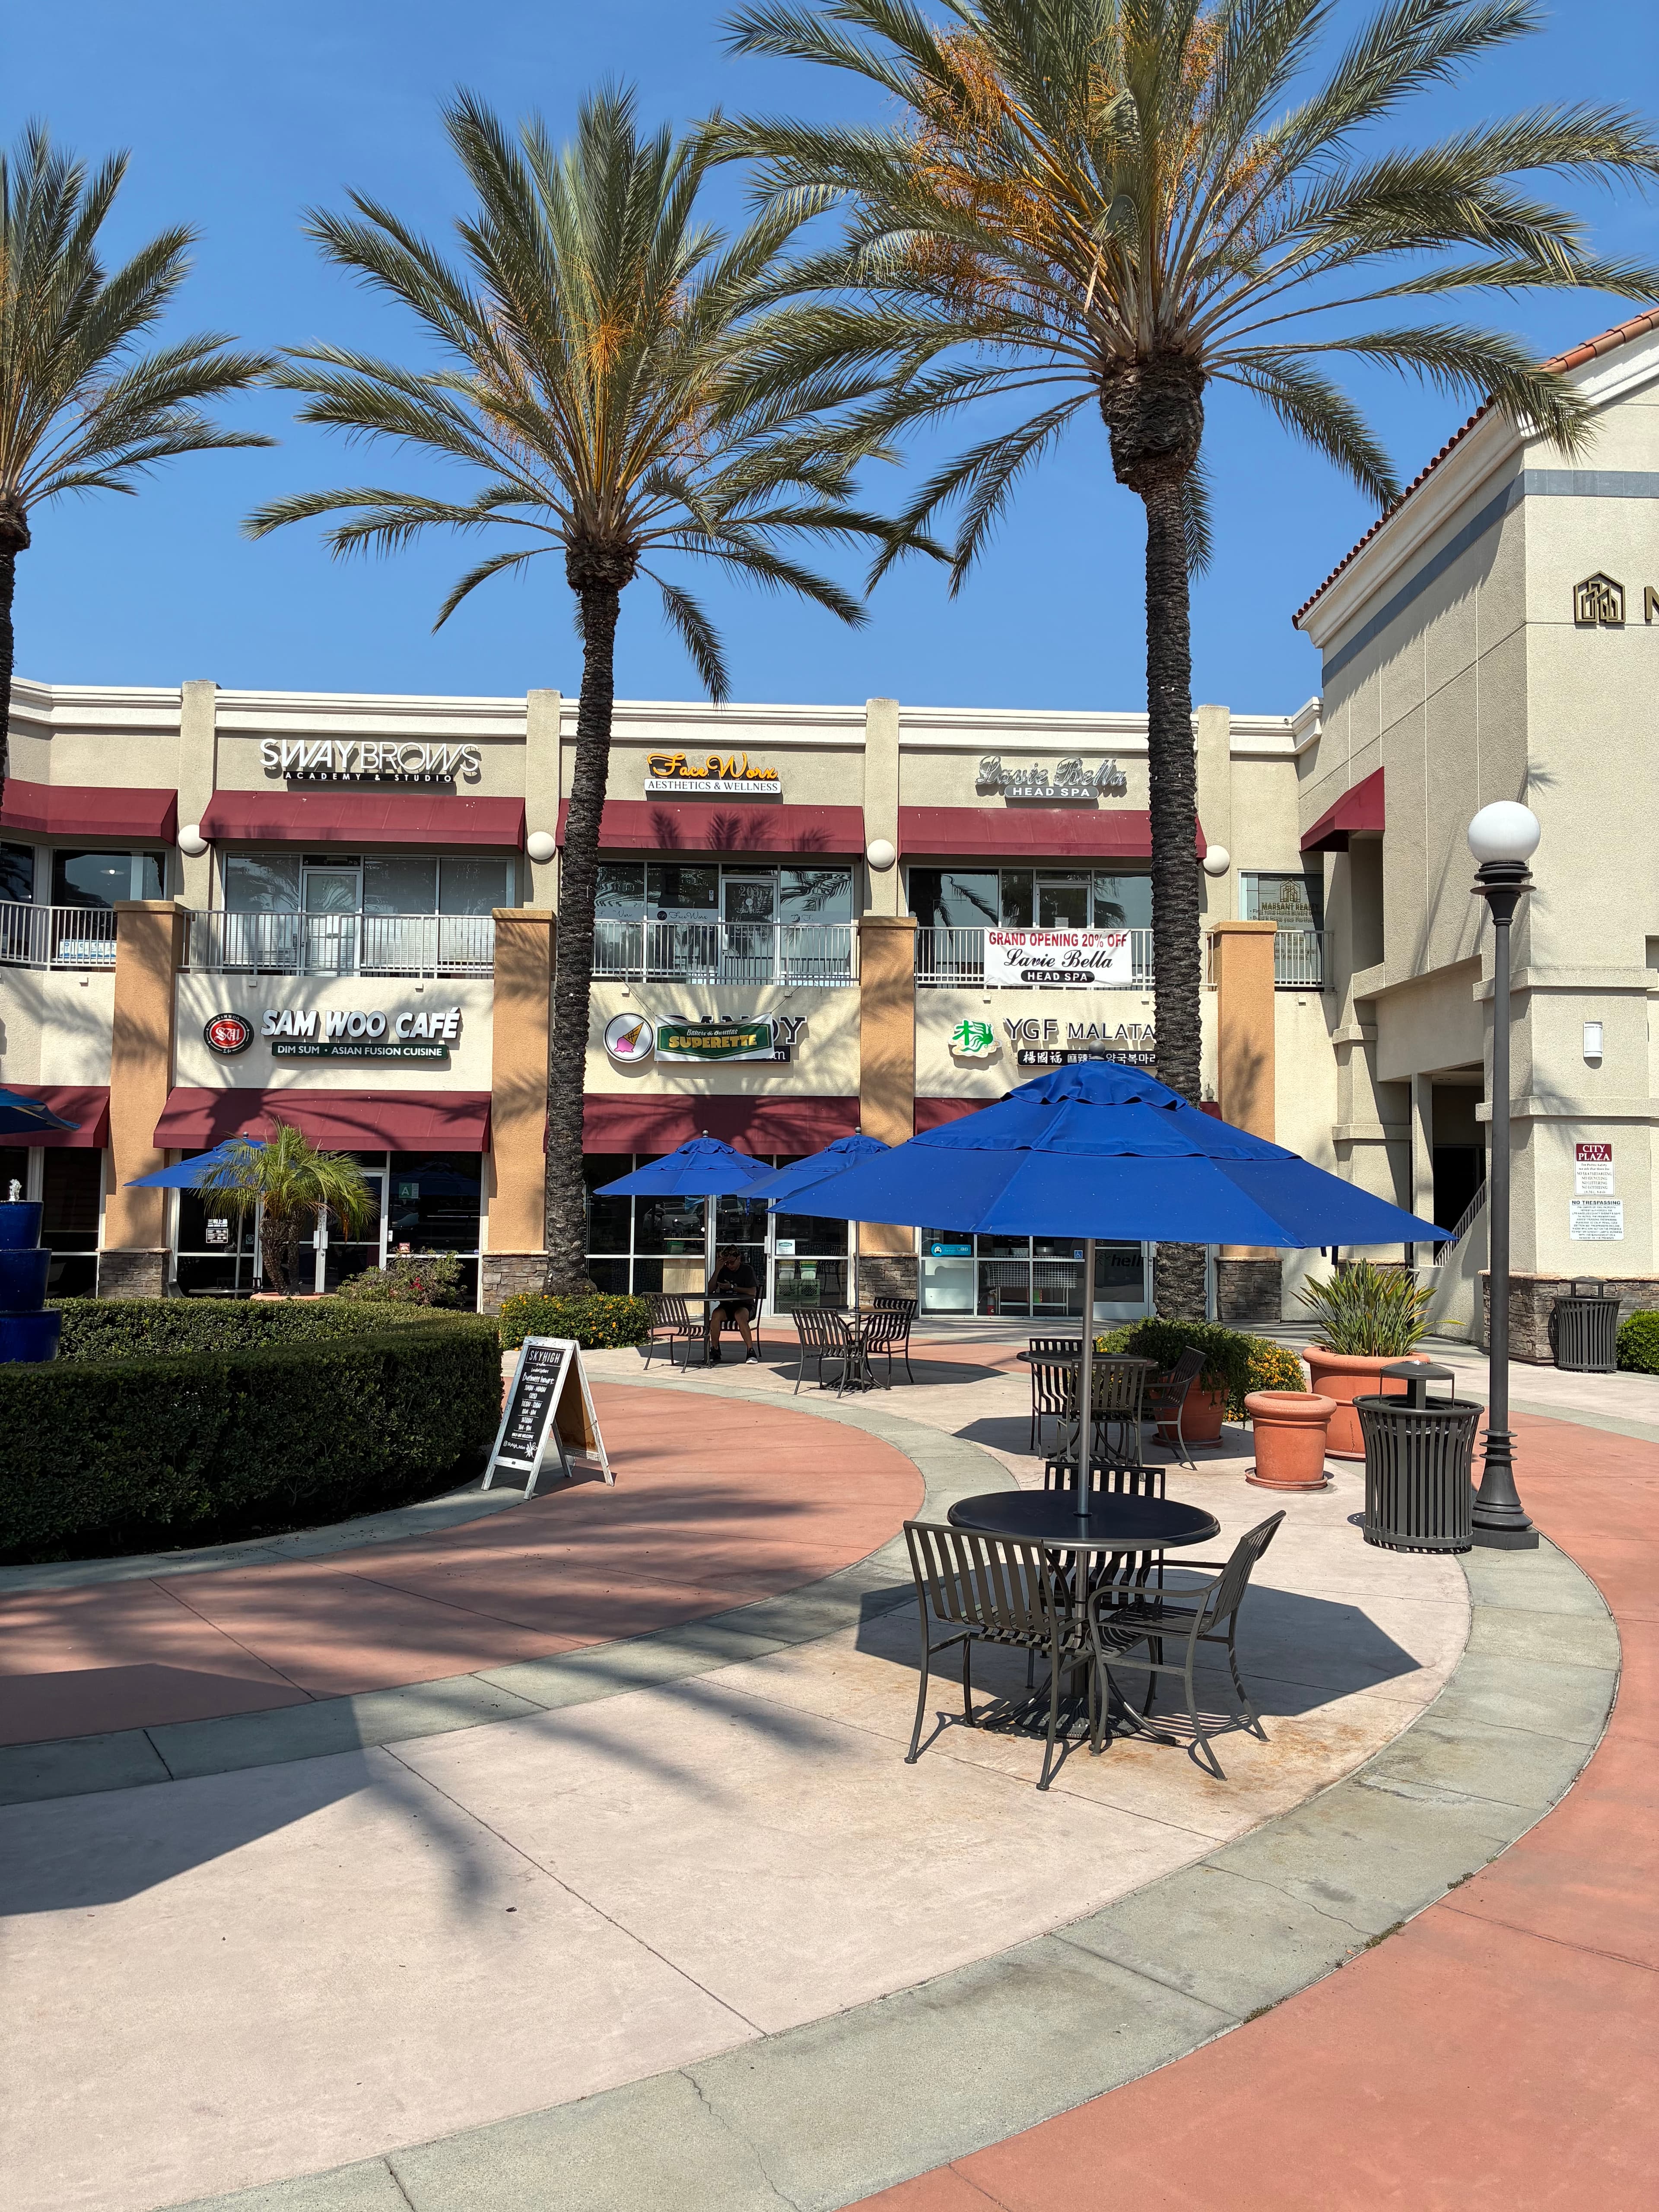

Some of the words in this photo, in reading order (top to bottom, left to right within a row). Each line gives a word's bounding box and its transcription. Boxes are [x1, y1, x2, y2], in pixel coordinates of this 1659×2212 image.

[286, 772, 361, 781] ACADEMY
[395, 774, 451, 782] STUDIO
[975, 756, 1049, 785] Lavie
[1053, 757, 1126, 787] Bella
[648, 781, 711, 790] AESTHETICS
[714, 782, 721, 790] &
[724, 782, 778, 791] WELLNESS
[1013, 787, 1054, 796] HEAD
[1061, 788, 1090, 797] SPA
[989, 932, 1026, 946] GRAND
[1030, 933, 1079, 947] OPENING
[1082, 934, 1103, 948] 20%
[1107, 934, 1127, 947] OFF
[1004, 948, 1055, 967] Lavie
[1062, 950, 1112, 968] Bella
[1028, 972, 1060, 981] HEAD
[1065, 973, 1087, 981] SPA
[261, 1009, 319, 1037] SAM
[325, 1010, 388, 1038] WOO
[395, 1007, 461, 1039] CAFÉ
[1006, 1018, 1058, 1040] YGF
[669, 1034, 757, 1049] SUPERETTE
[277, 1046, 297, 1054] DIM
[298, 1046, 319, 1054] SUM
[403, 1049, 442, 1057] CUISINE
[1023, 1051, 1062, 1064] 楊國福
[401, 1187, 410, 1195] A
[529, 1350, 561, 1364] SKYHIGH
[522, 1372, 540, 1382] Business
